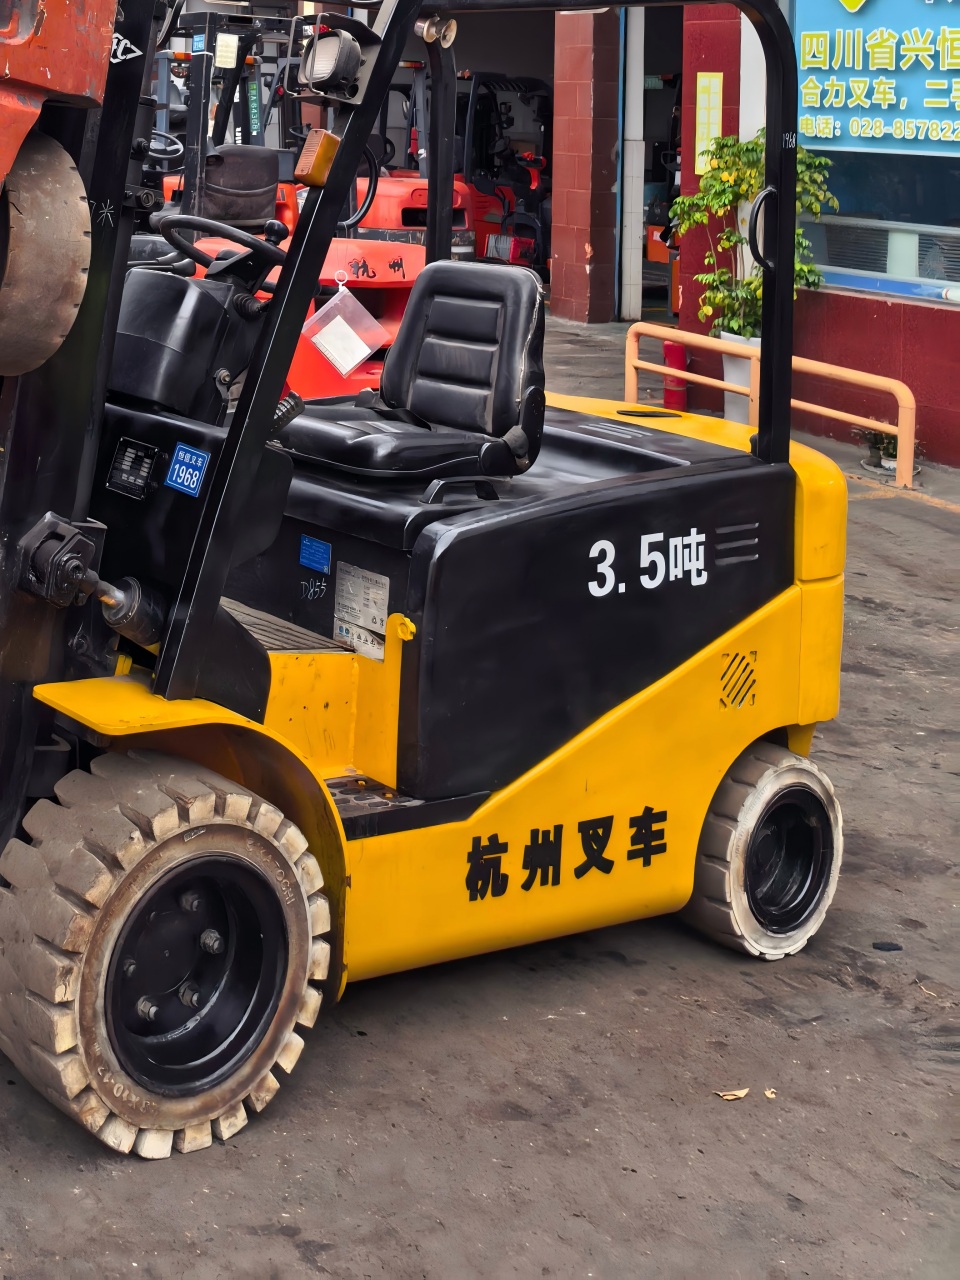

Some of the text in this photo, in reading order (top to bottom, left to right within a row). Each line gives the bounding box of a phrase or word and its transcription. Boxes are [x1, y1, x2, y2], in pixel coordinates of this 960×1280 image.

[799, 26, 960, 71] 四川省兴恒
[172, 463, 200, 488] 1968
[588, 527, 708, 597] 3.5吨
[465, 806, 668, 902] 杭州叉车
